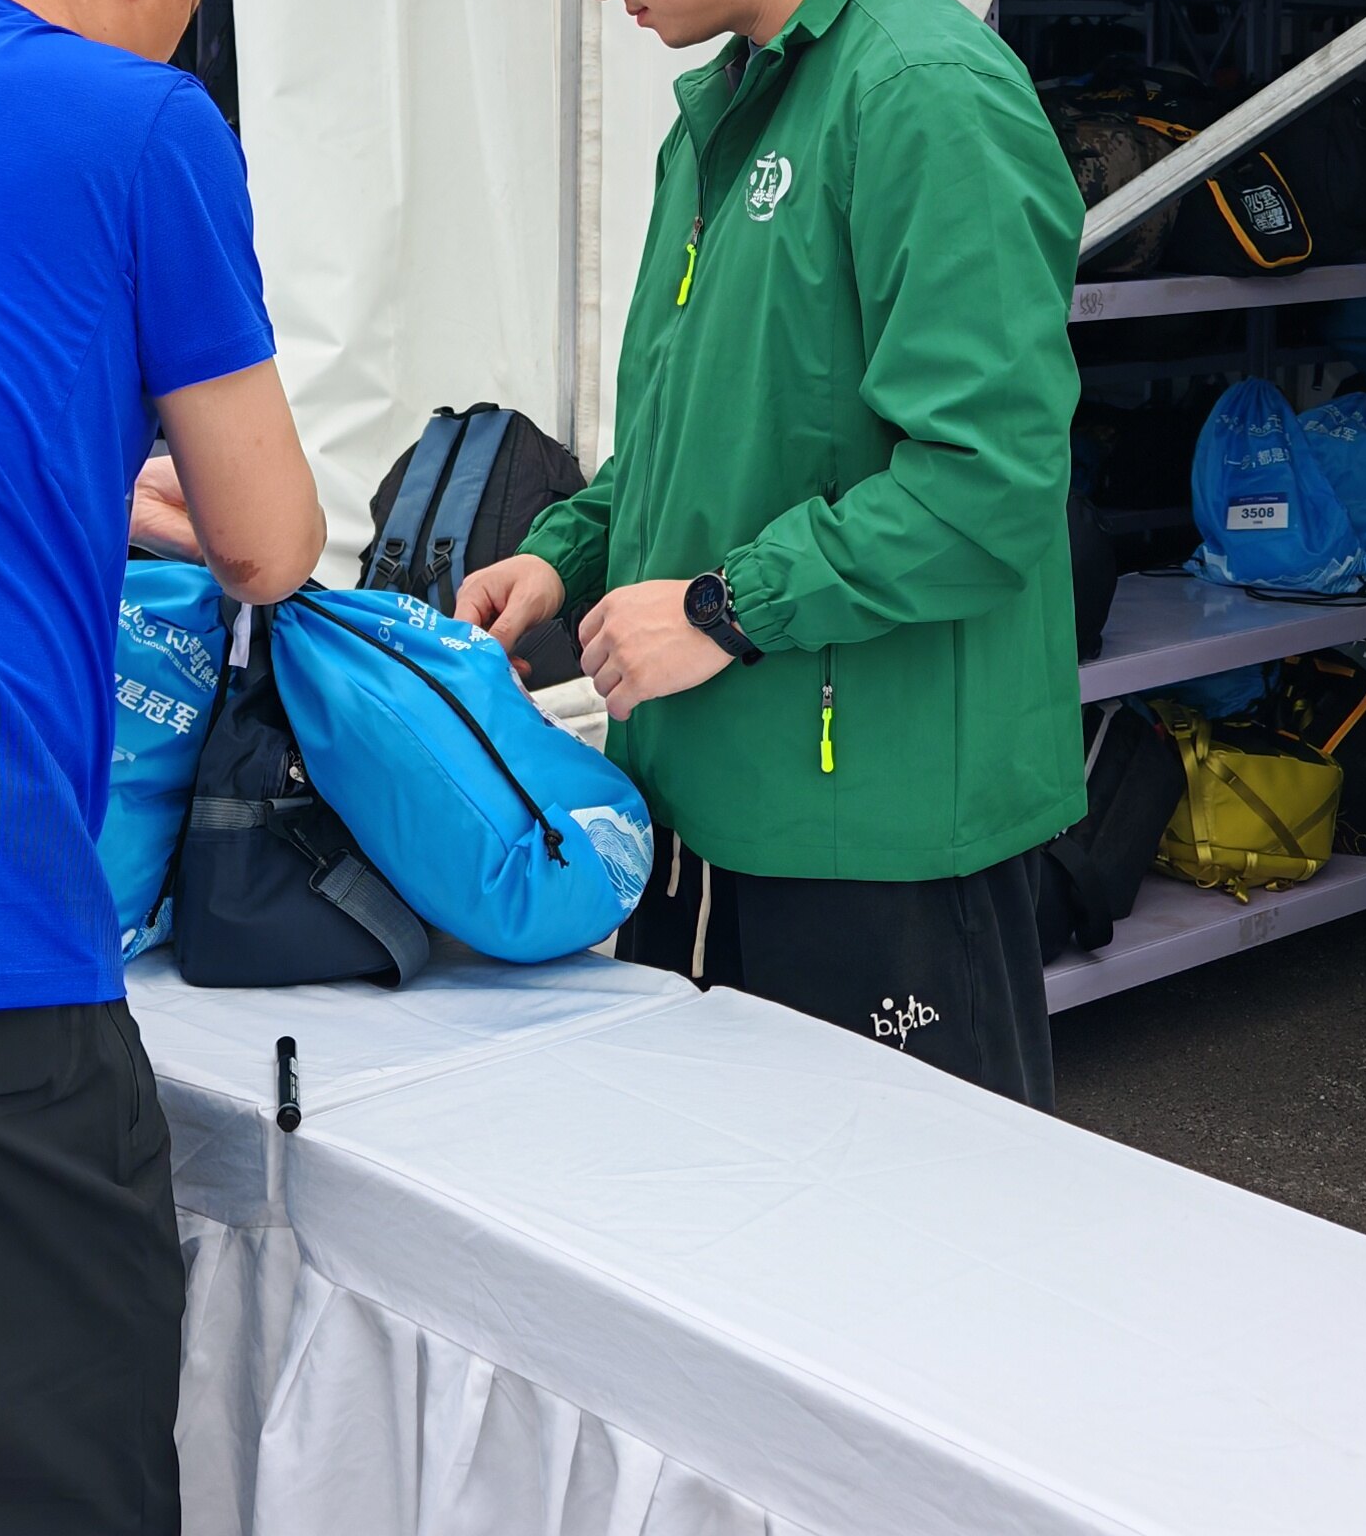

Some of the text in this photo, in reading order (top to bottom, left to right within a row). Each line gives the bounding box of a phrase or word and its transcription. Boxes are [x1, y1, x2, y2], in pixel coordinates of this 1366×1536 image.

[1241, 507, 1275, 520] 3508
[115, 672, 199, 735] 是冠军
